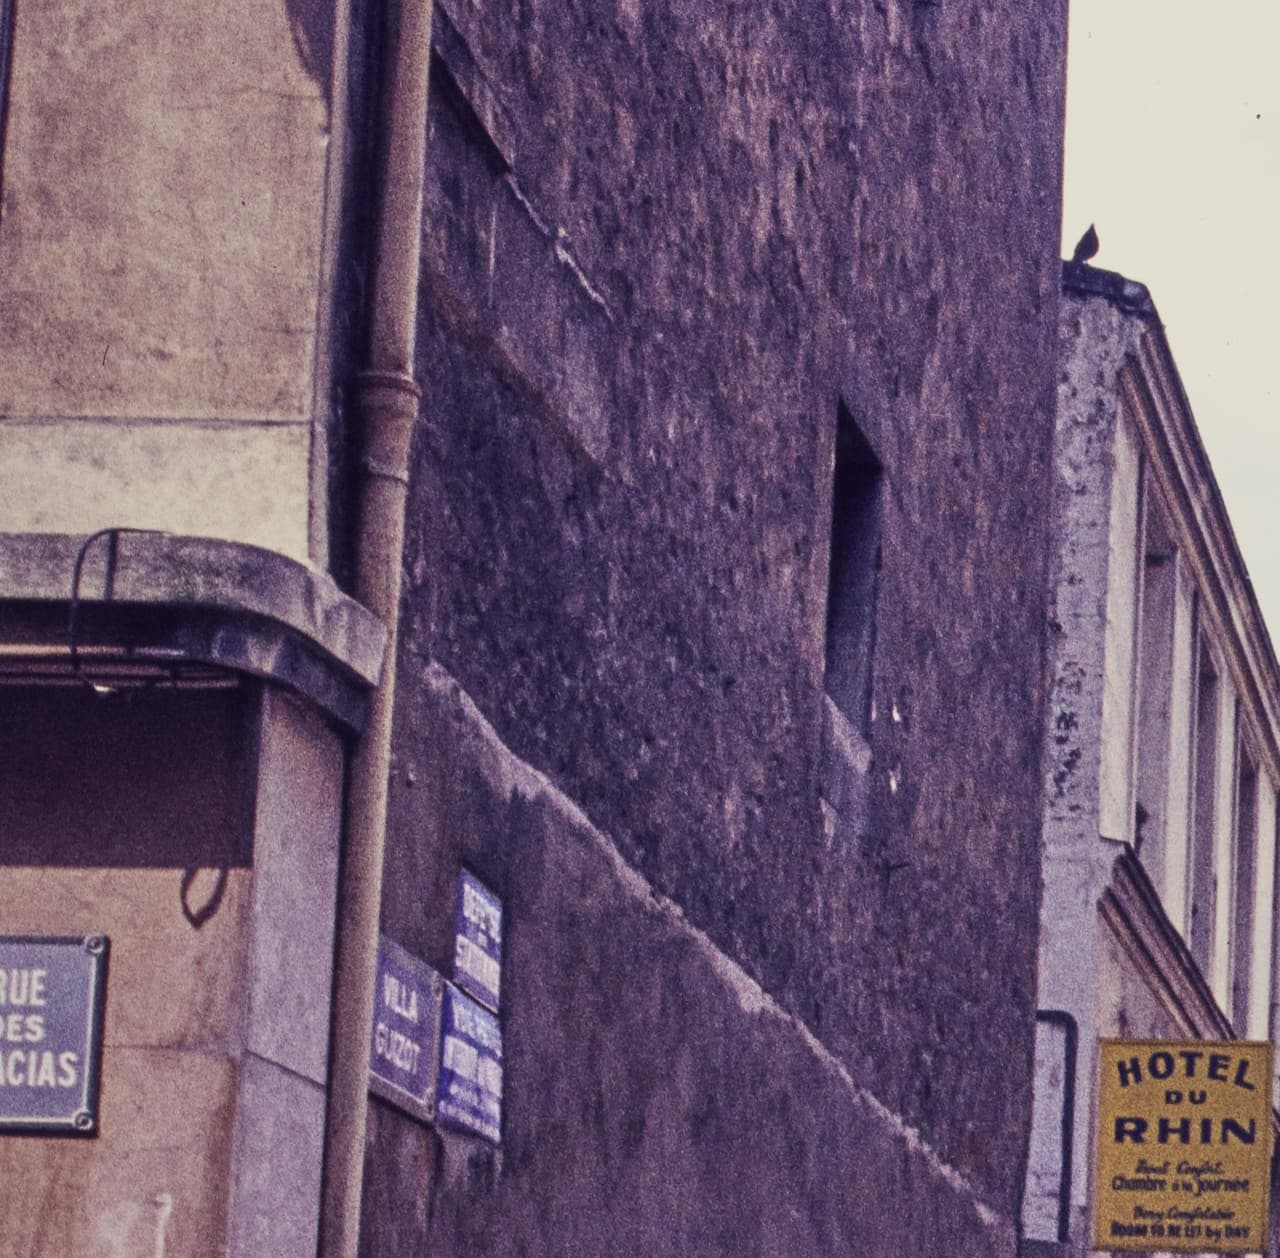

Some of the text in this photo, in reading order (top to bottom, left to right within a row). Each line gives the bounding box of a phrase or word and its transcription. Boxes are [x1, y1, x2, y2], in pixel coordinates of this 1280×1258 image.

[0, 1013, 46, 1042] ES
[1116, 1051, 1256, 1090] HOTEL
[1165, 1090, 1207, 1105] DU
[1114, 1116, 1256, 1145] RHIN
